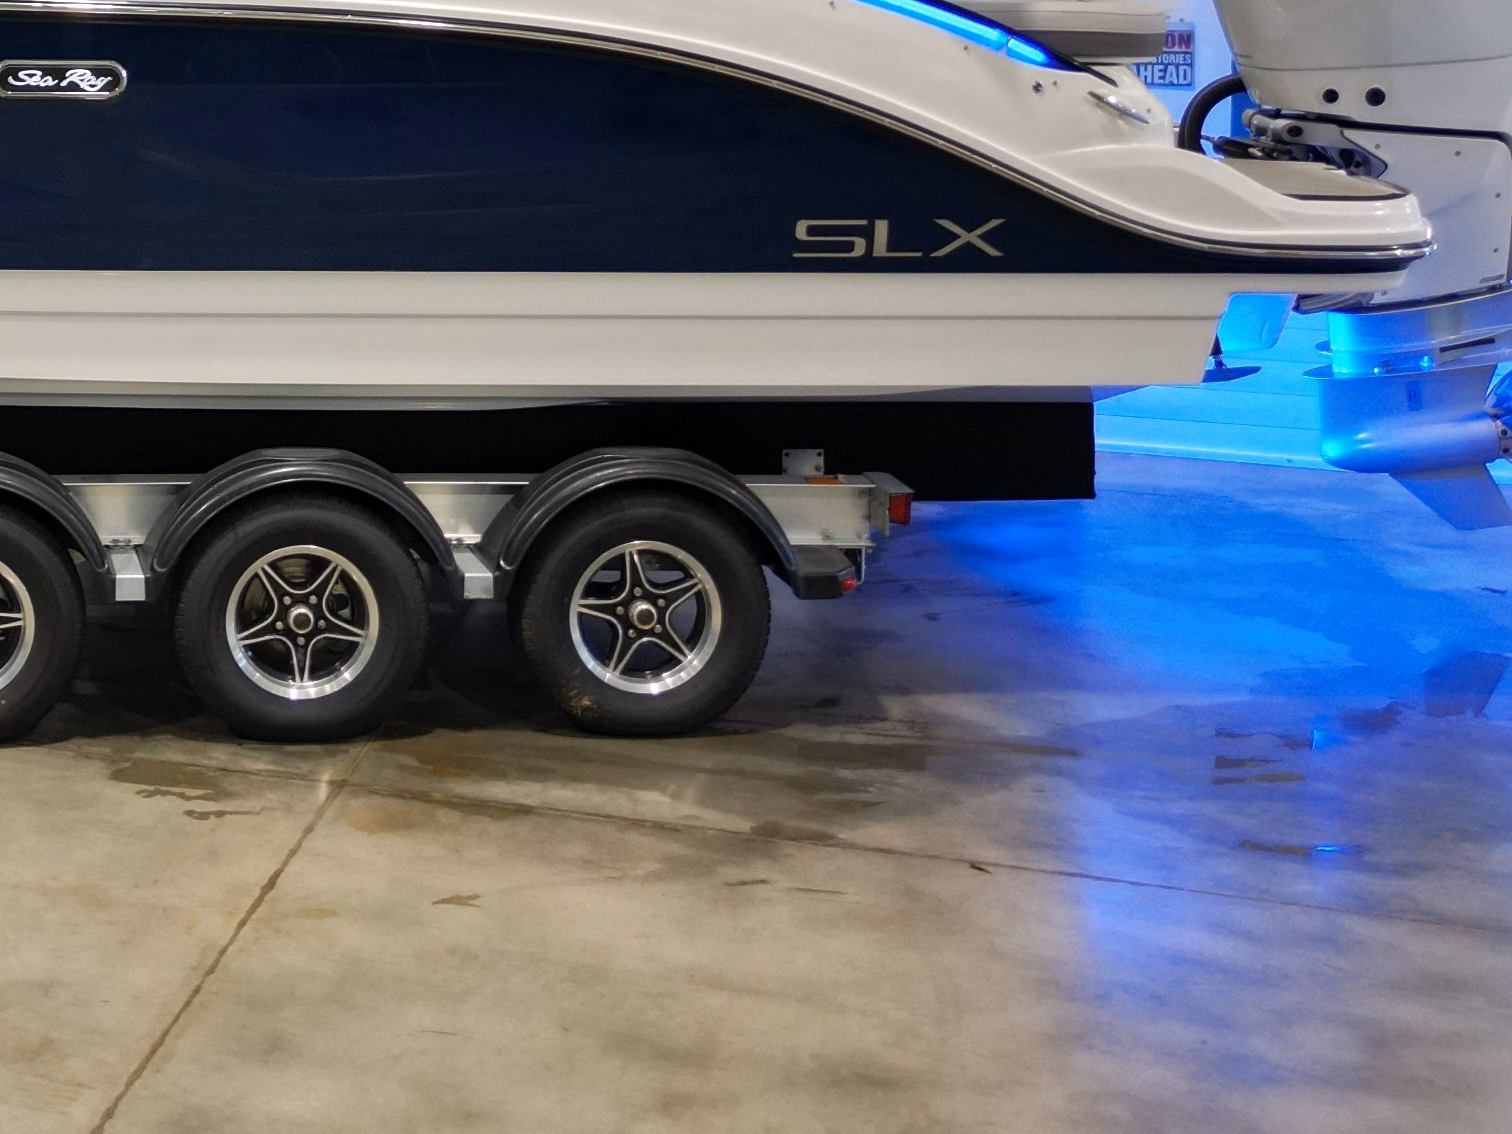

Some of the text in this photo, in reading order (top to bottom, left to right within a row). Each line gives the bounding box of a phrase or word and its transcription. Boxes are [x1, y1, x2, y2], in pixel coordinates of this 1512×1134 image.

[7, 68, 113, 92] Sea Ray
[792, 218, 1007, 258] SLX
